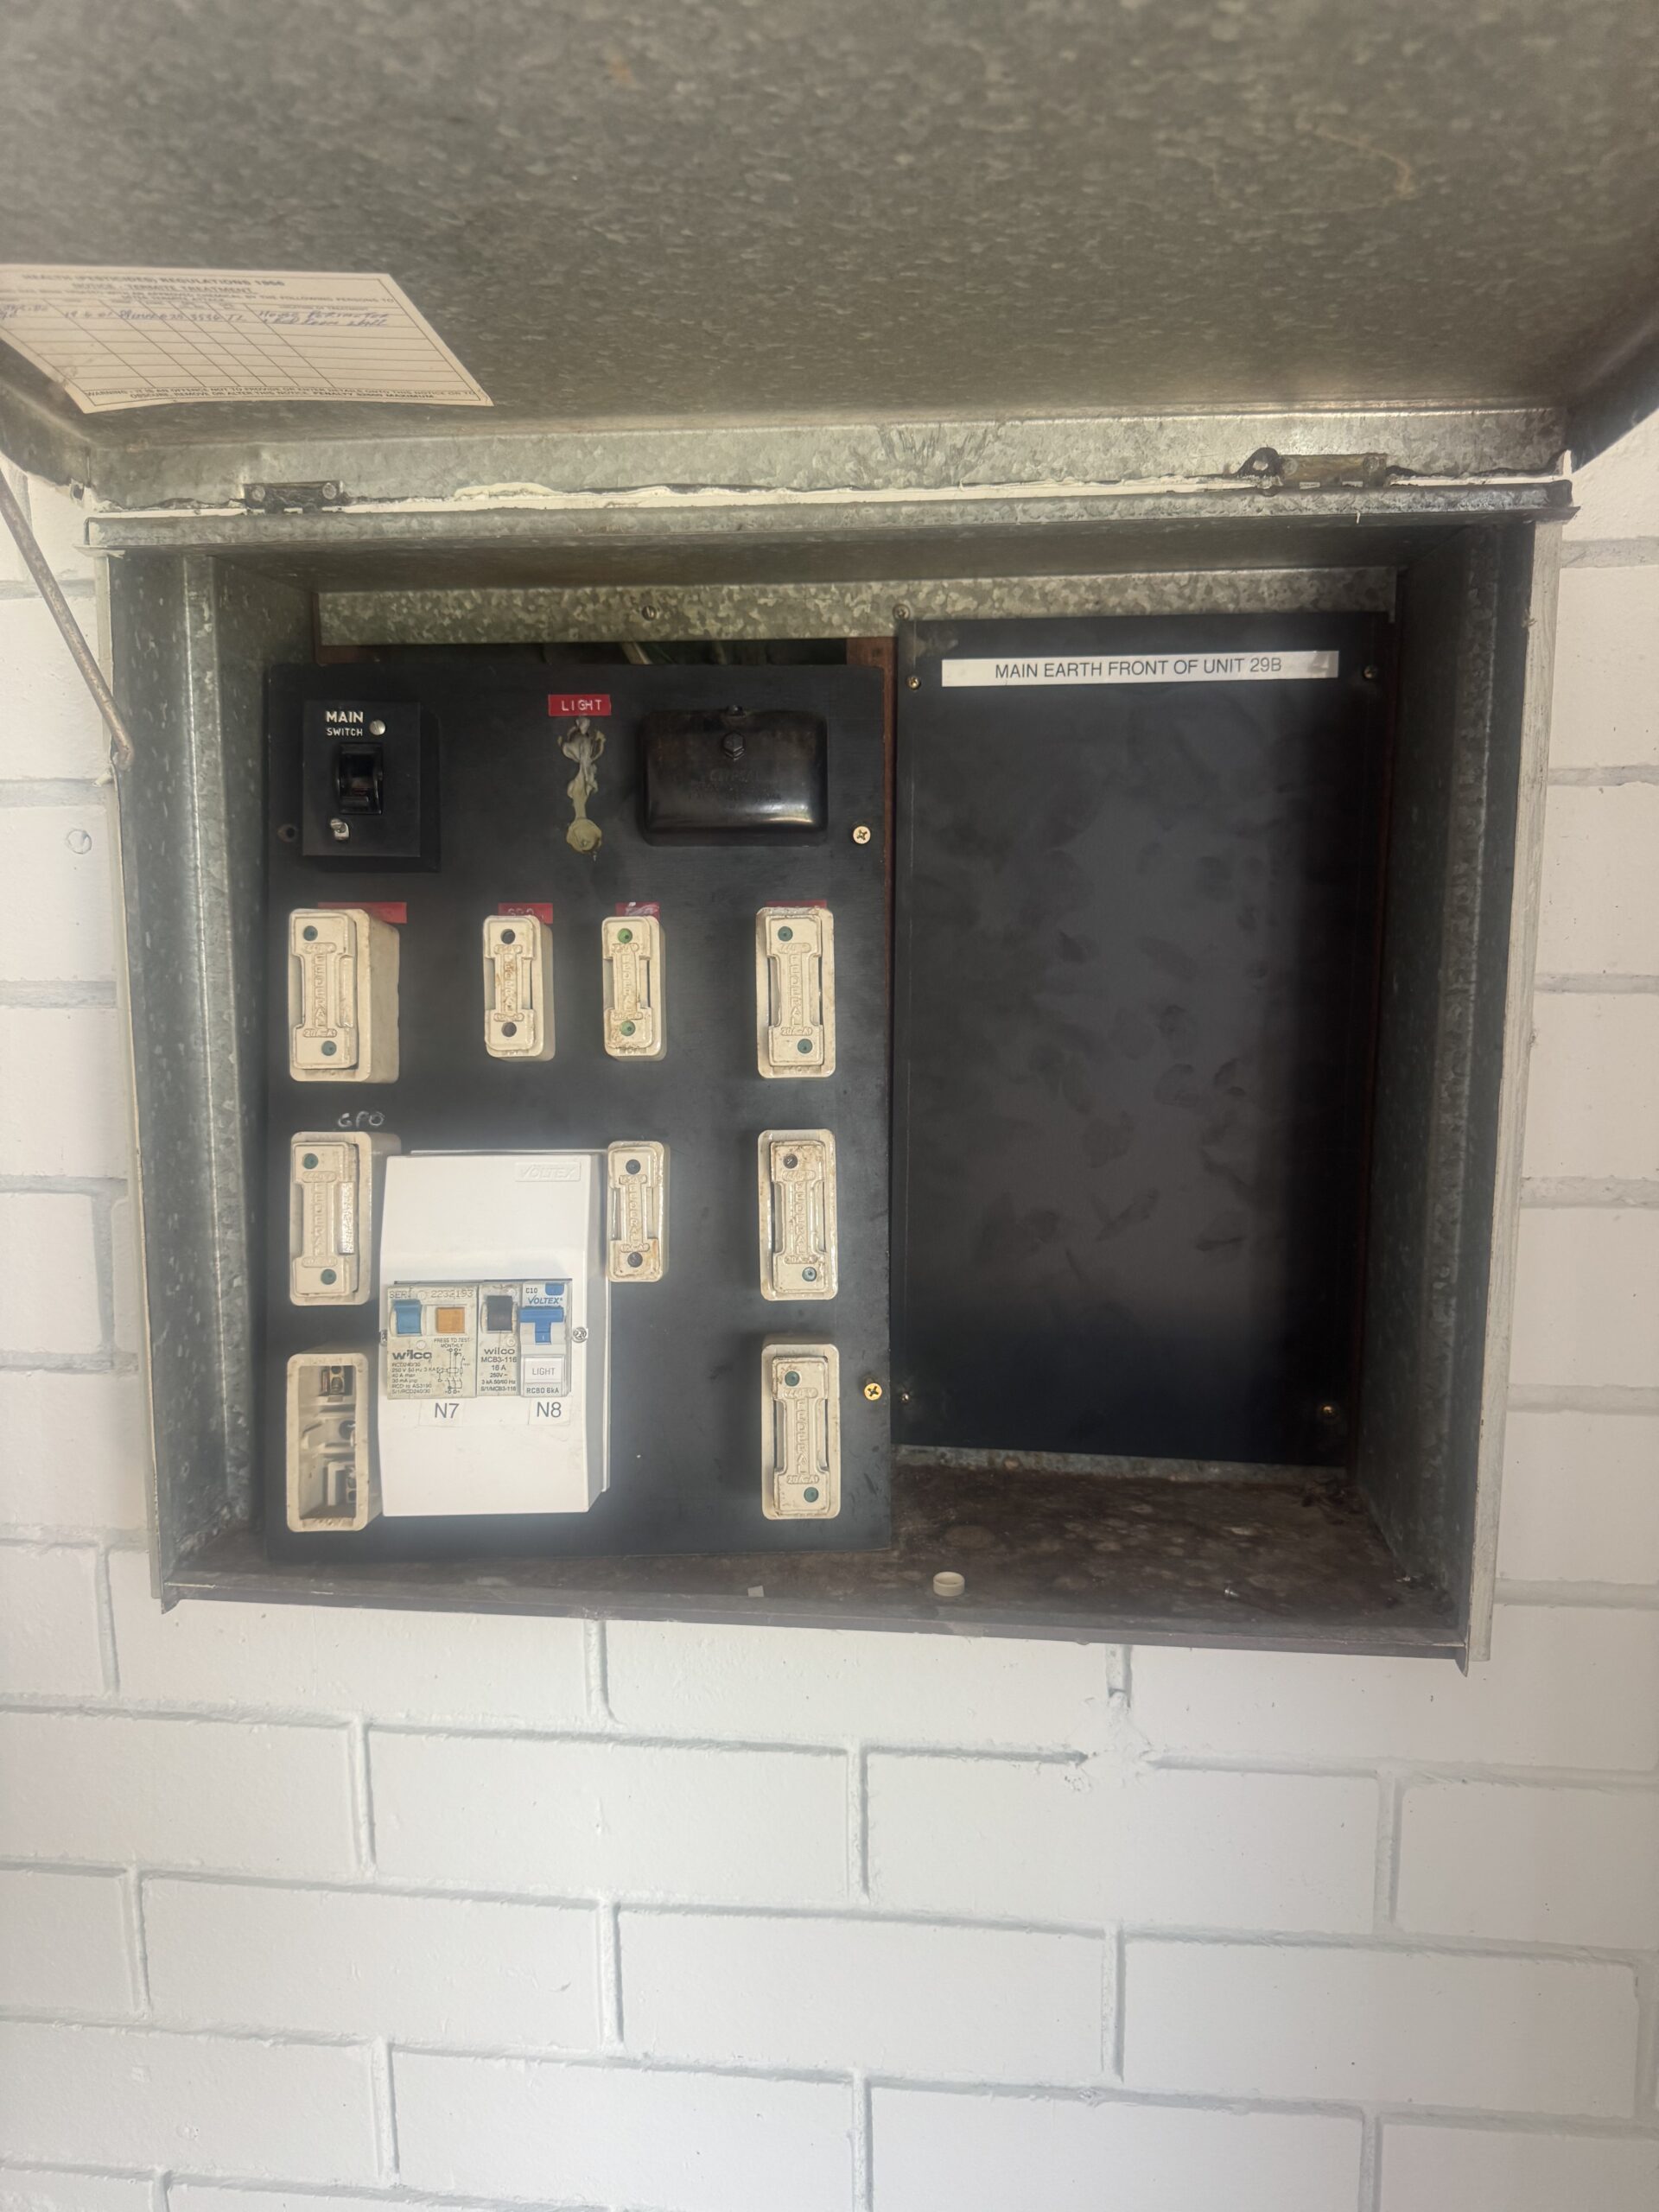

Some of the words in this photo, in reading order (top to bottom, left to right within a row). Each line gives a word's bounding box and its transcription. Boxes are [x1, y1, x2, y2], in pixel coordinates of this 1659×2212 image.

[995, 664, 1038, 679] MAIN
[1044, 662, 1103, 677] EARTH
[1108, 660, 1168, 676] FRONT
[1173, 659, 1198, 675] OF
[1204, 658, 1244, 674] UNIT
[1249, 657, 1282, 673] 29B
[561, 699, 602, 711] LIGHT
[325, 710, 364, 723] MAIN
[326, 727, 364, 737] SWITCH
[338, 1110, 385, 1128] GPO
[434, 1402, 460, 1419] N7
[537, 1402, 563, 1419] N8
